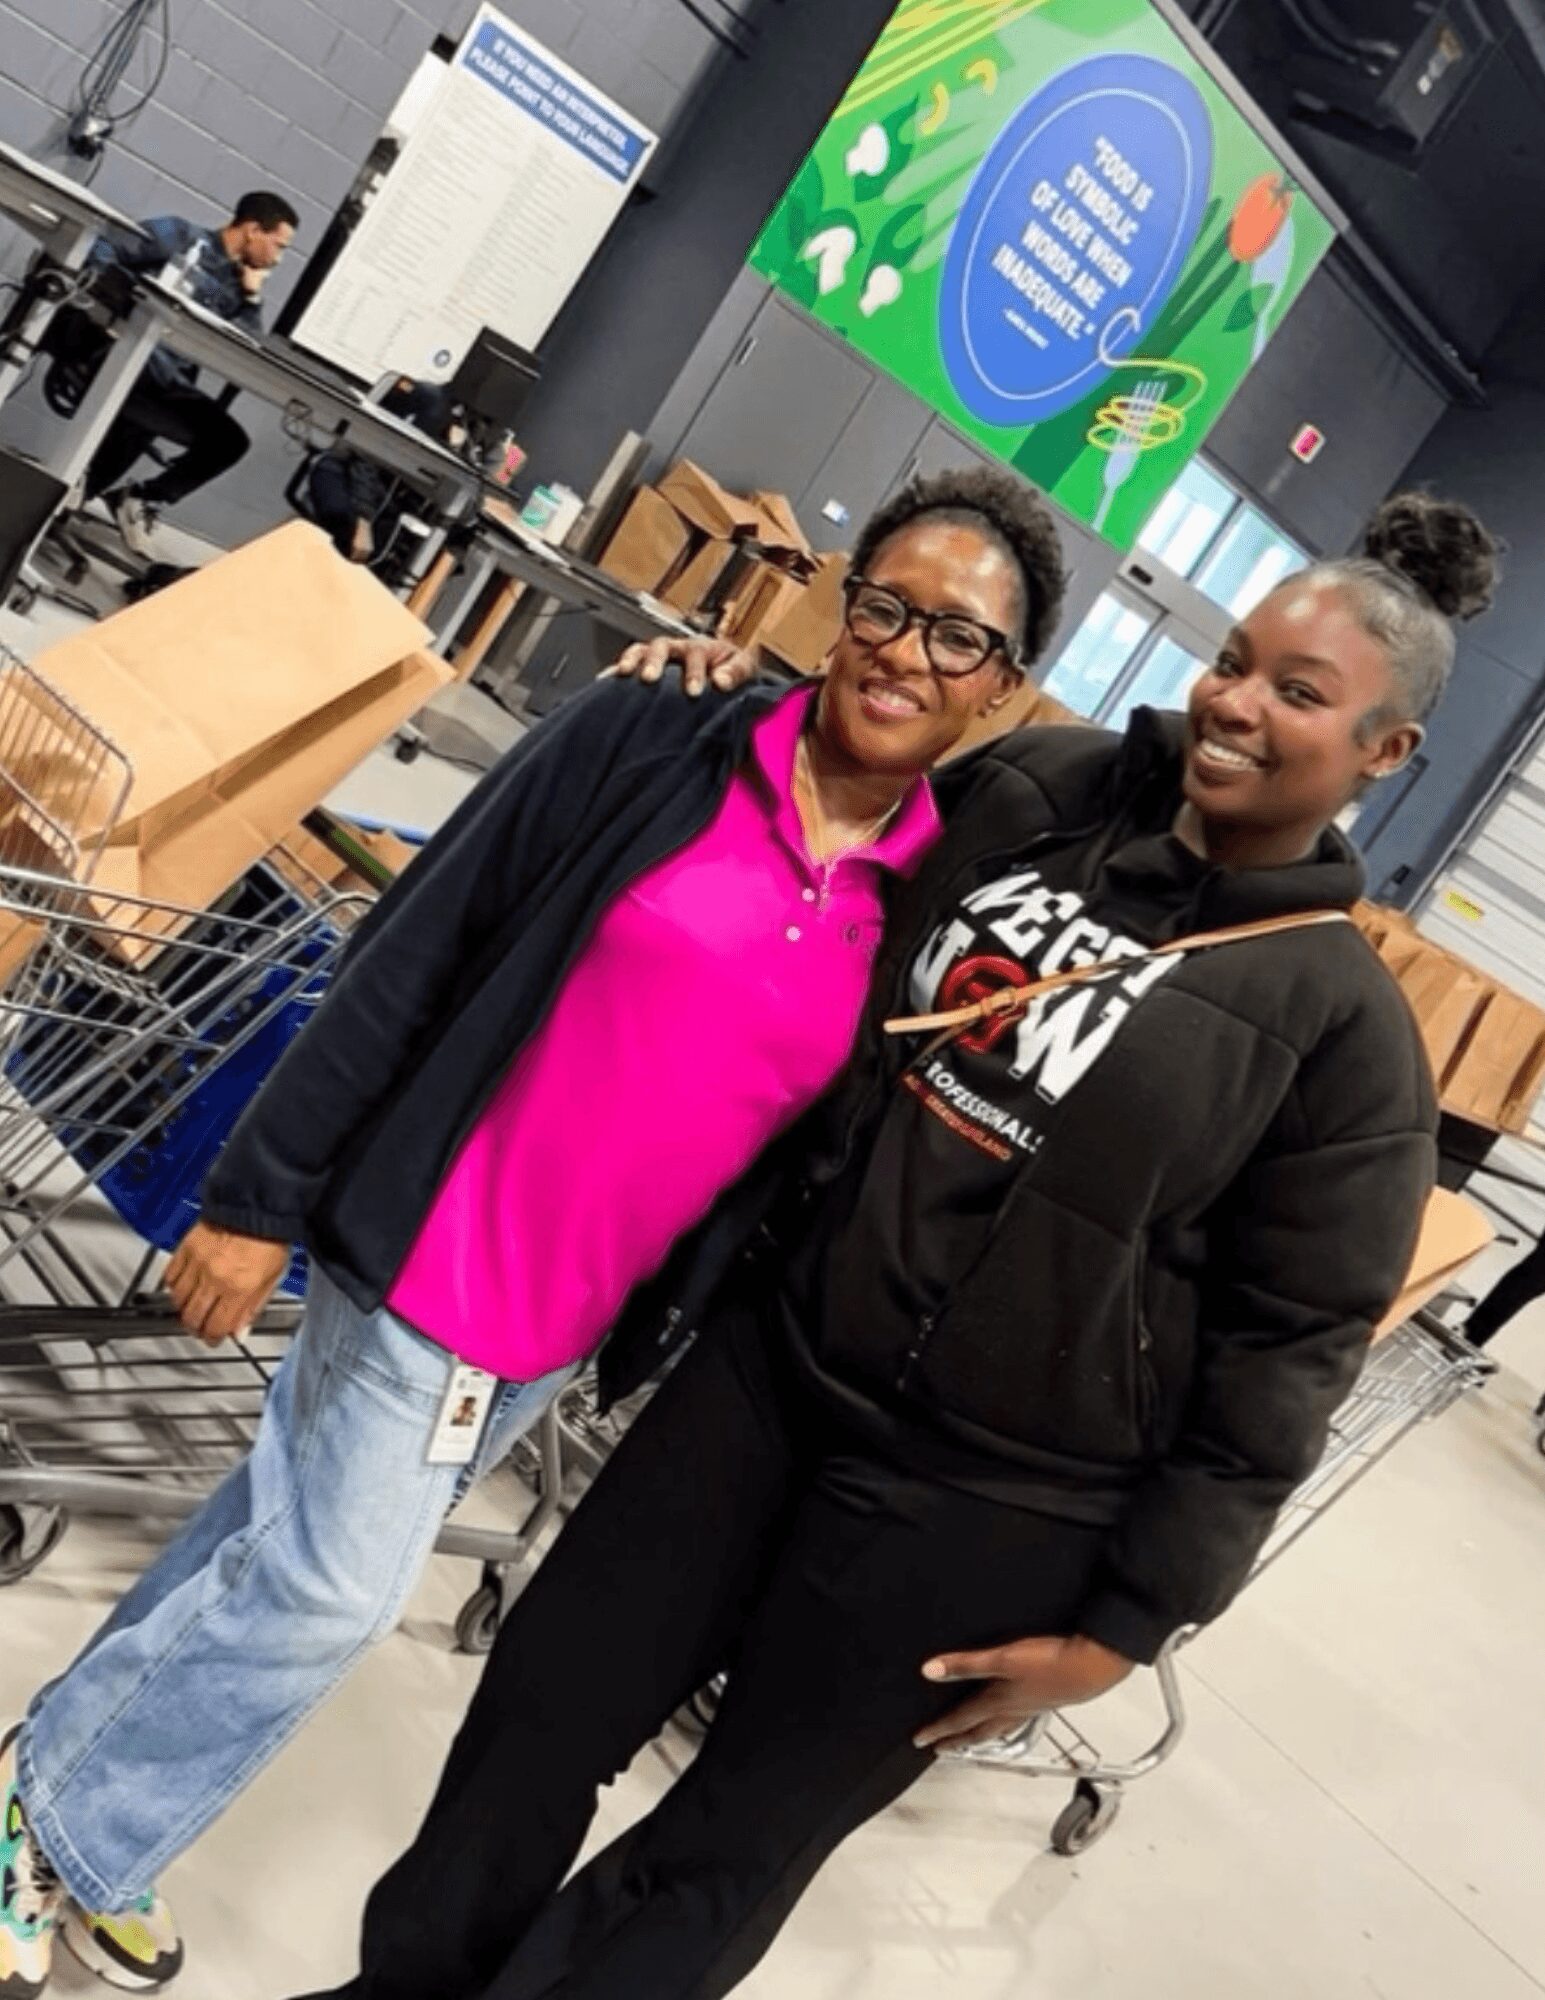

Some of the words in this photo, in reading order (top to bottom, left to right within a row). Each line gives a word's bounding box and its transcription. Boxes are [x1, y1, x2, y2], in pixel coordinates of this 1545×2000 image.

[1031, 179, 1061, 213] OF
[1050, 200, 1095, 250] LOVE
[1085, 232, 1134, 289] WHEN
[1065, 162, 1140, 245] SYMBOLIC
[1130, 181, 1154, 212] IS
[1021, 218, 1079, 284] WORDS
[1069, 269, 1106, 310] ARE
